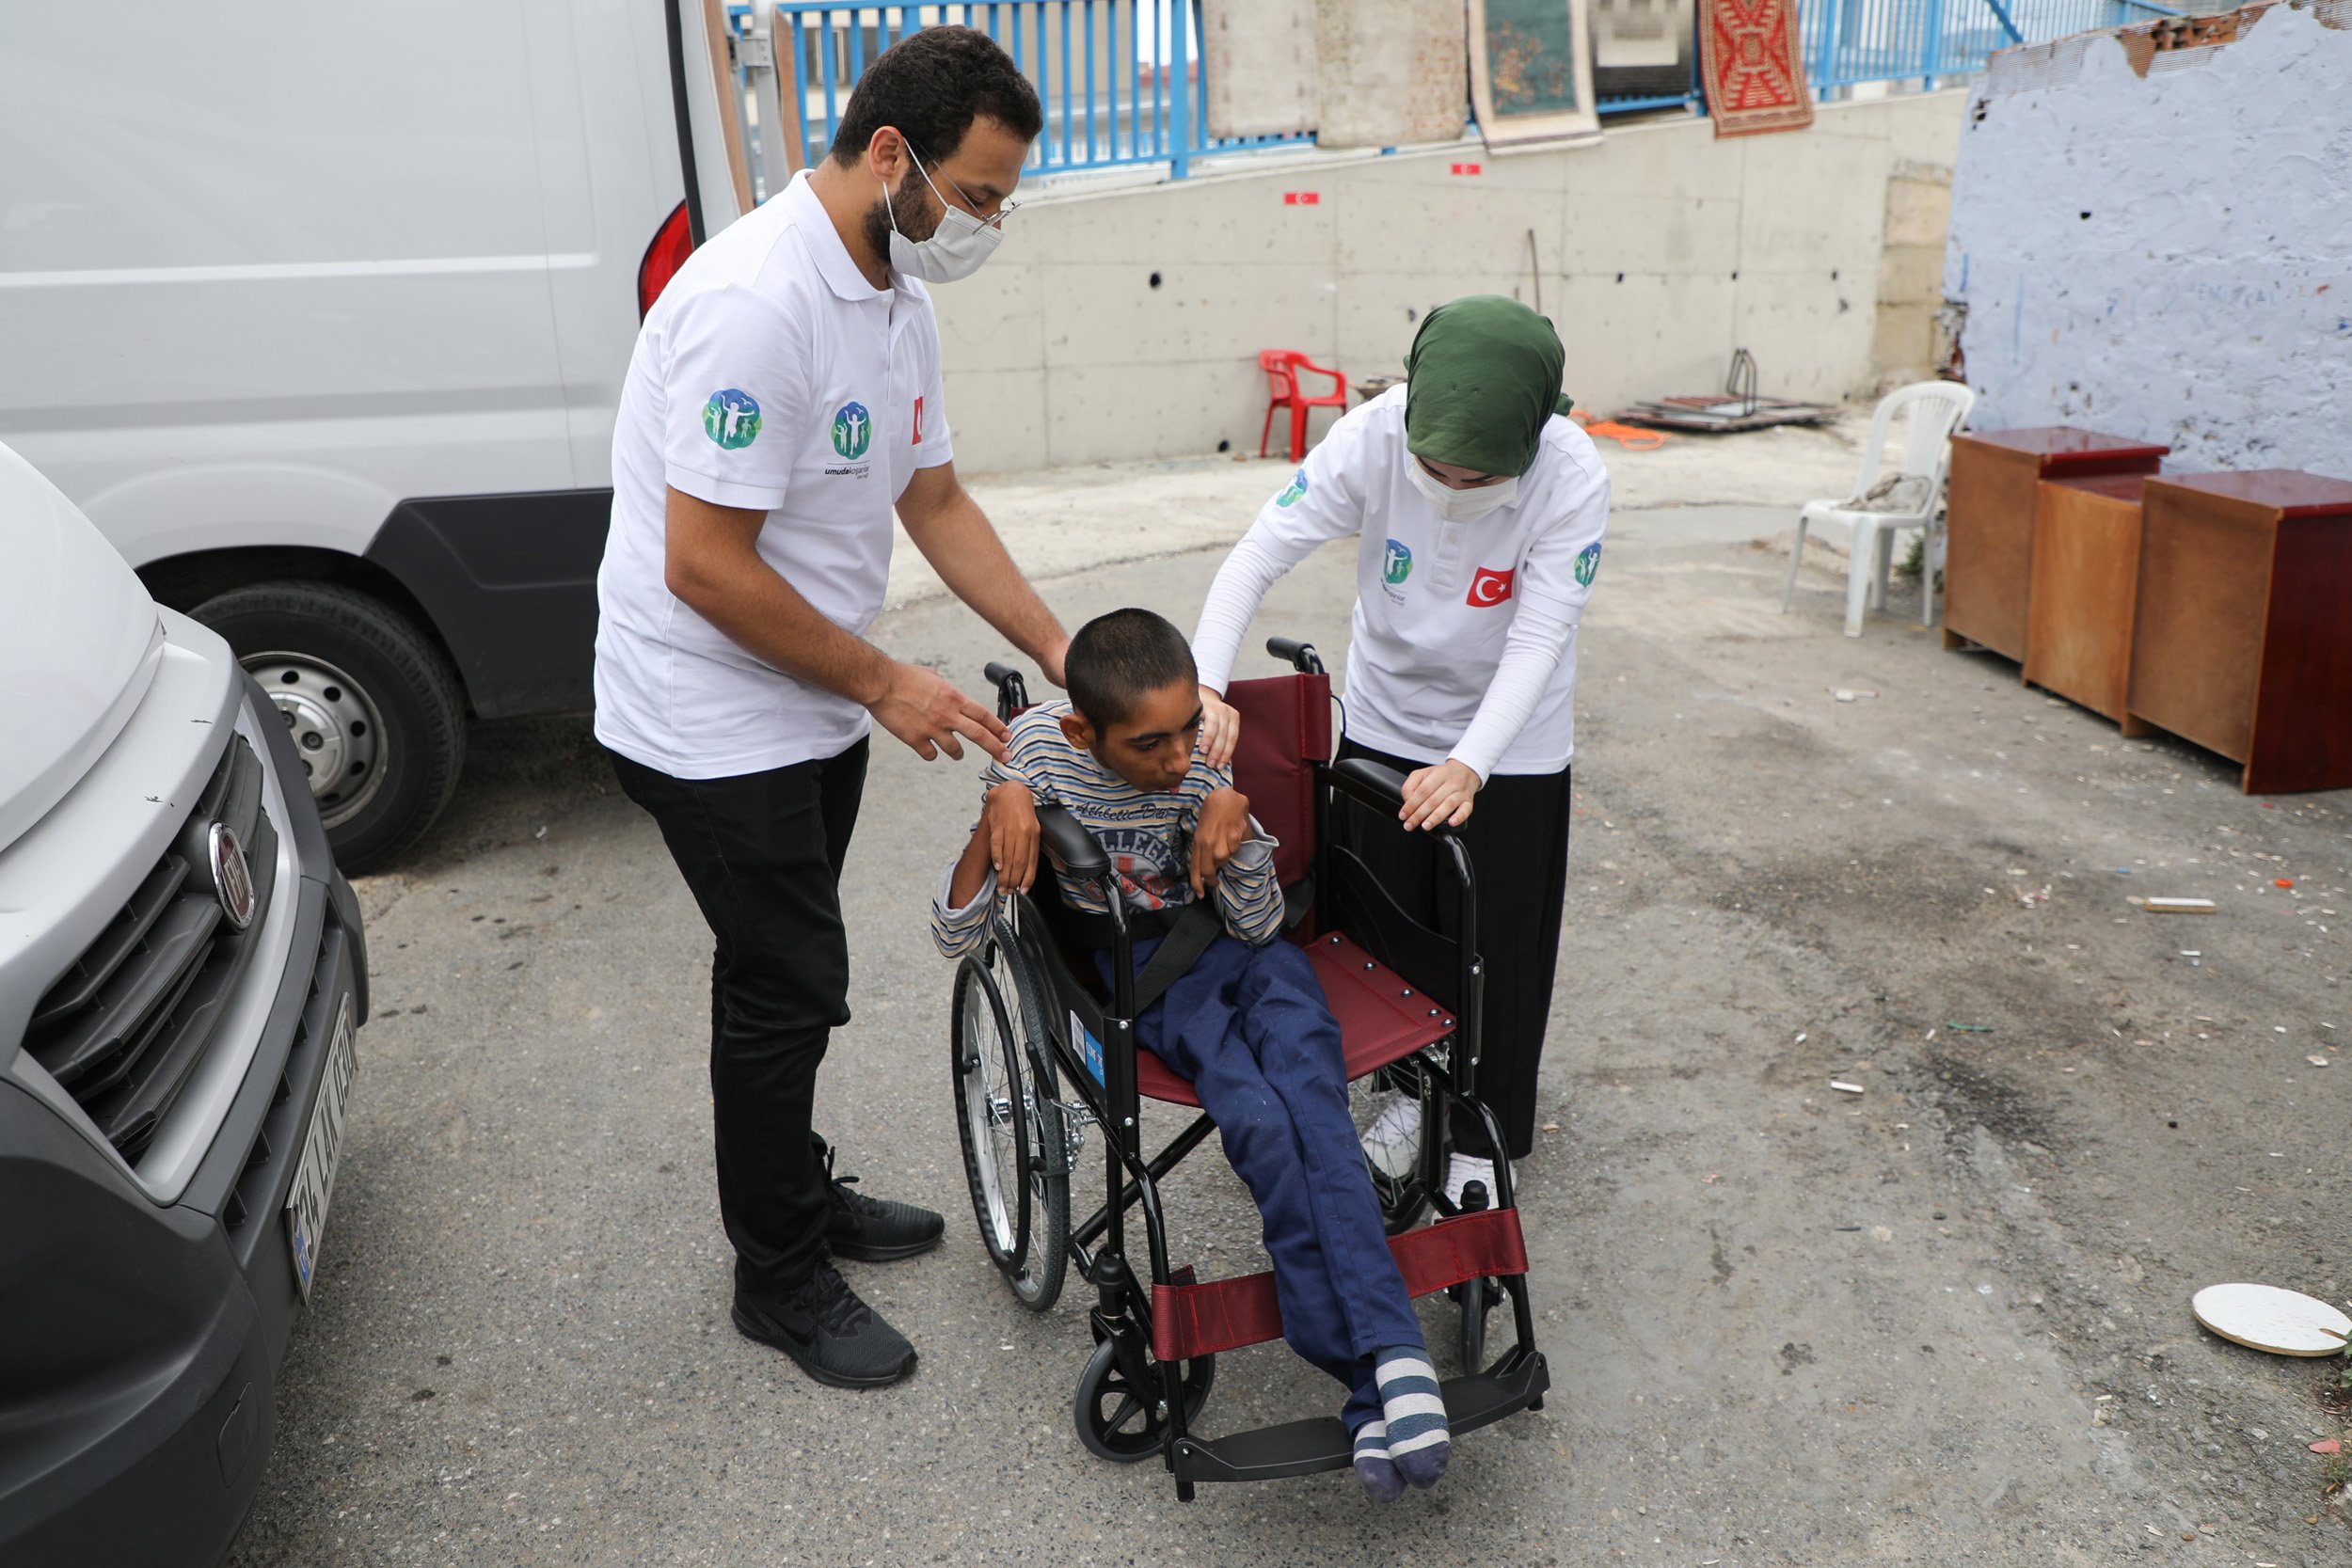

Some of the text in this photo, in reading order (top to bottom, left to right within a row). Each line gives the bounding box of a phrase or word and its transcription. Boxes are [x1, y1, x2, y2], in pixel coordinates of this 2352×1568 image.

[1076, 801, 1135, 821] Athletic
[1098, 828, 1173, 871] LLEGE
[299, 1016, 354, 1259] 34 LAK 030
